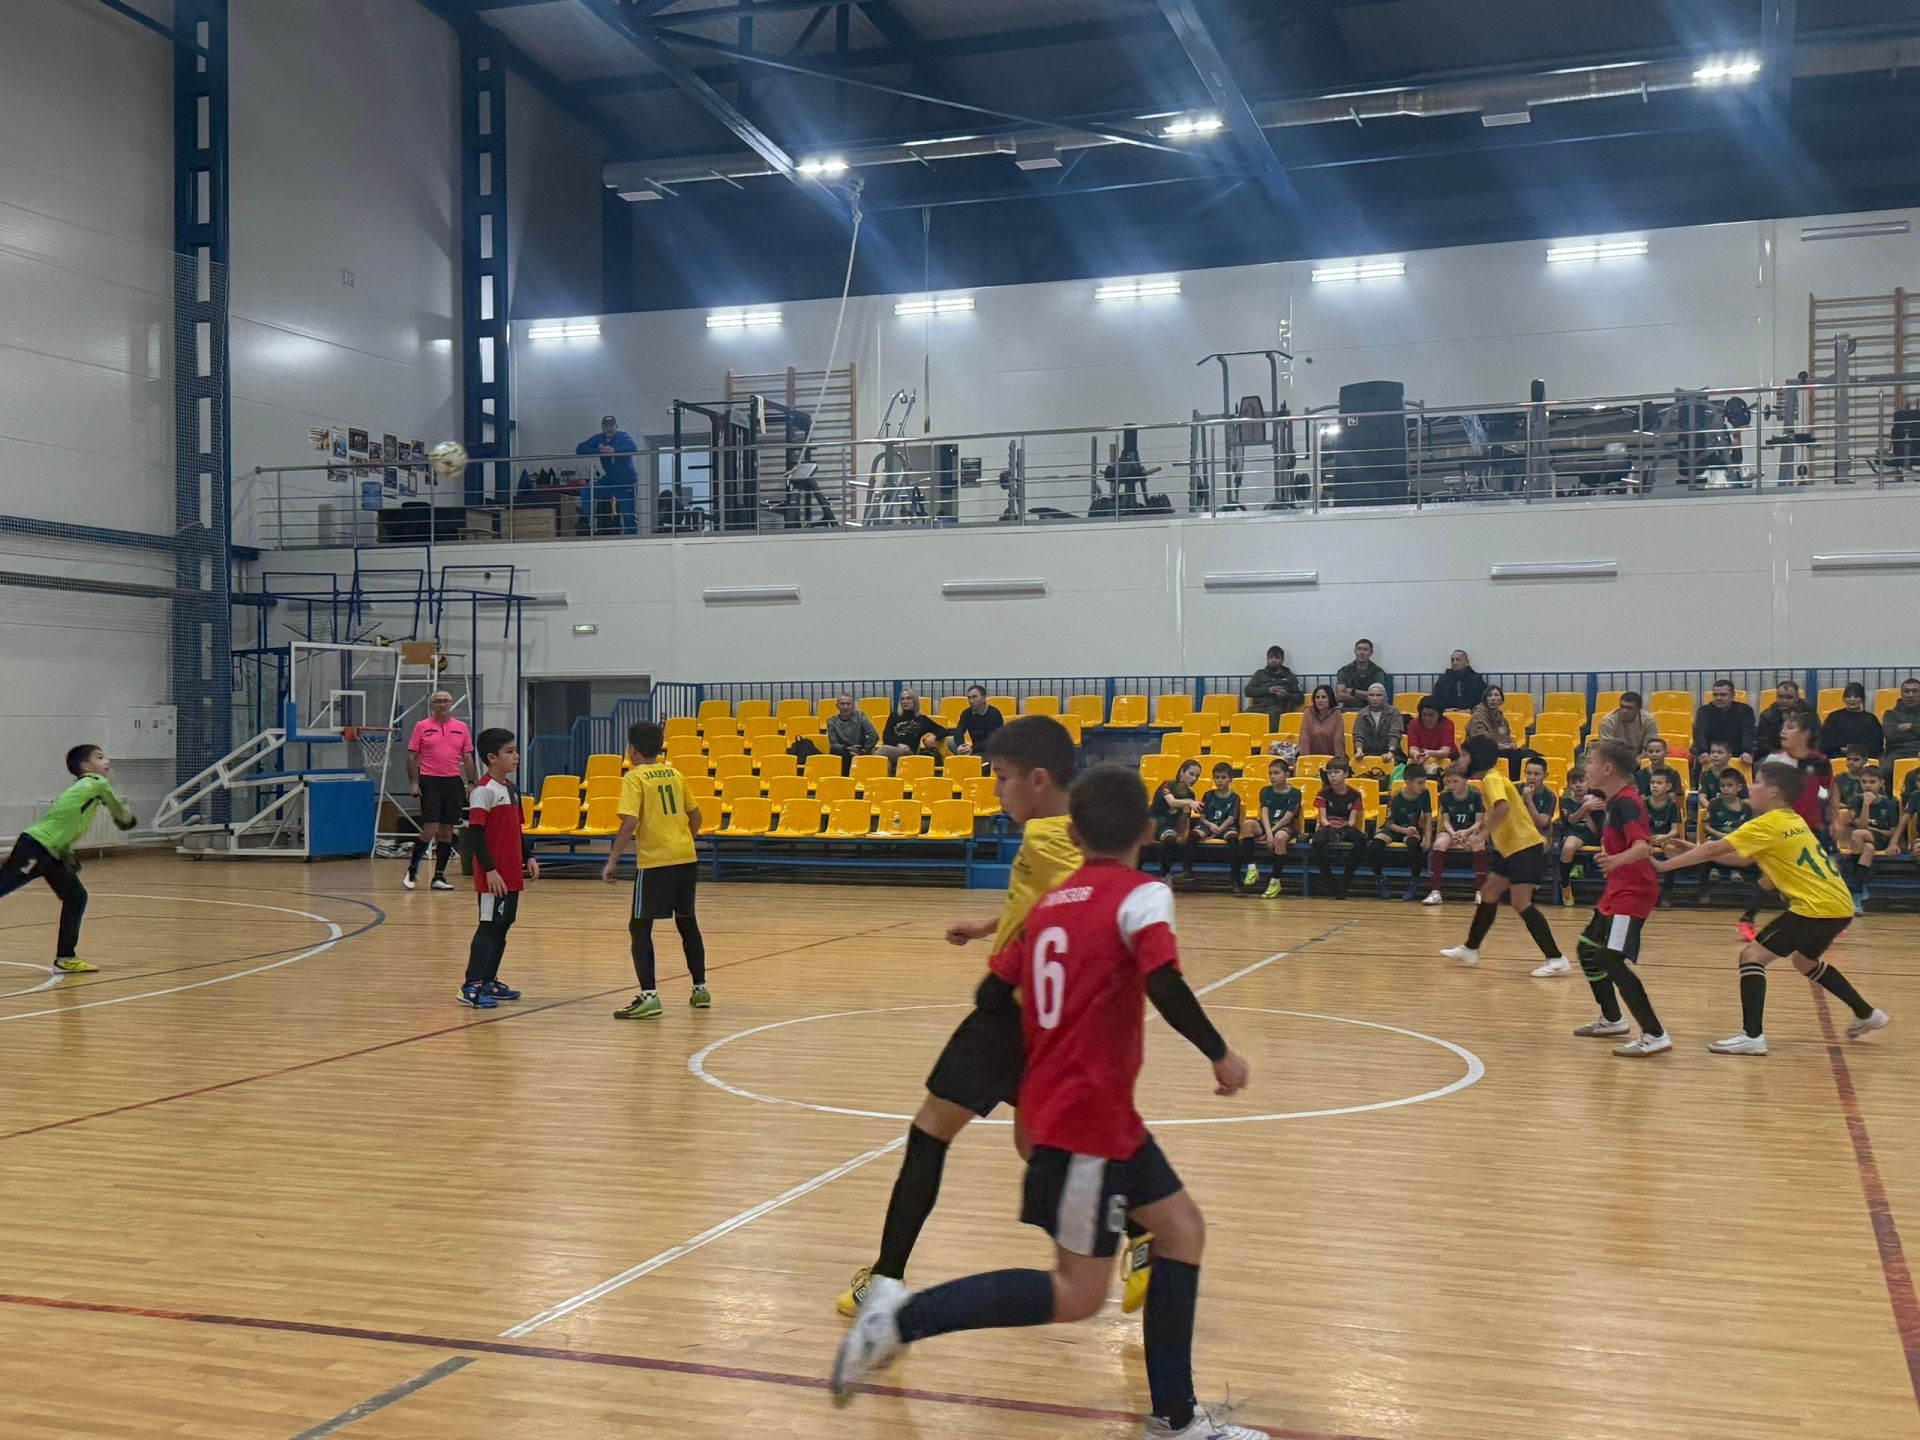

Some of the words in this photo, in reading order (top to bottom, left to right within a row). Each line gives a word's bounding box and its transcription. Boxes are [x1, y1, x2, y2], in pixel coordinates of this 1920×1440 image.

[657, 784, 677, 815] 11
[1456, 813, 1467, 823] 77
[497, 900, 505, 916] 4
[1032, 926, 1069, 1030] 6
